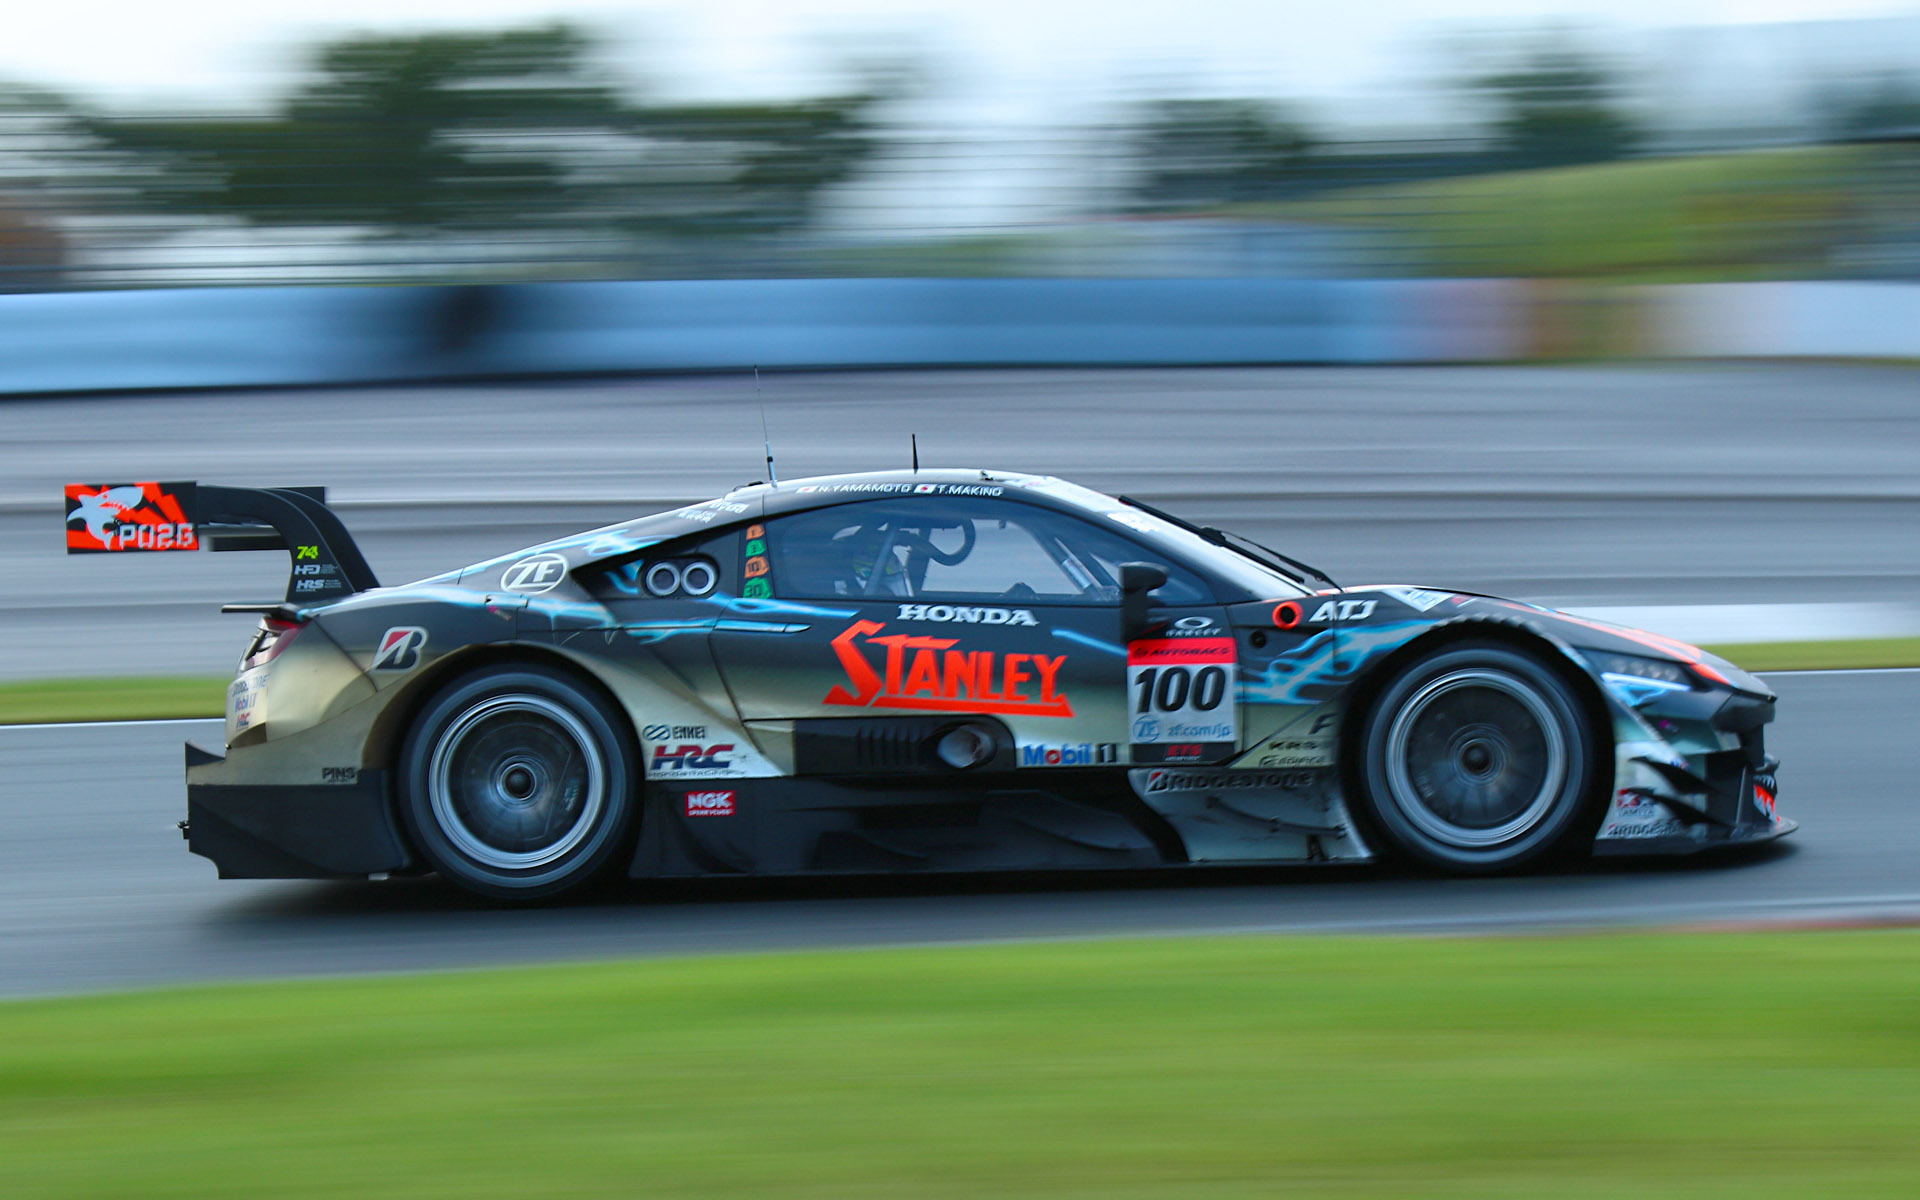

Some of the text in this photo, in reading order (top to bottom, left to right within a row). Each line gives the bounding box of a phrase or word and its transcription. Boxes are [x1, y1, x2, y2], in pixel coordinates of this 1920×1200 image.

[937, 485, 1004, 497] T.MAKINO
[296, 545, 319, 560] 74
[897, 602, 1041, 627] HONDA
[822, 619, 1076, 718] STANLEY
[1134, 666, 1226, 714] 100
[1168, 723, 1232, 738] zf.com/jp
[650, 744, 736, 770] HRC
[1023, 743, 1091, 766] Mobil
[1146, 771, 1313, 793] BRIDGESTONE
[688, 792, 732, 809] NGK
